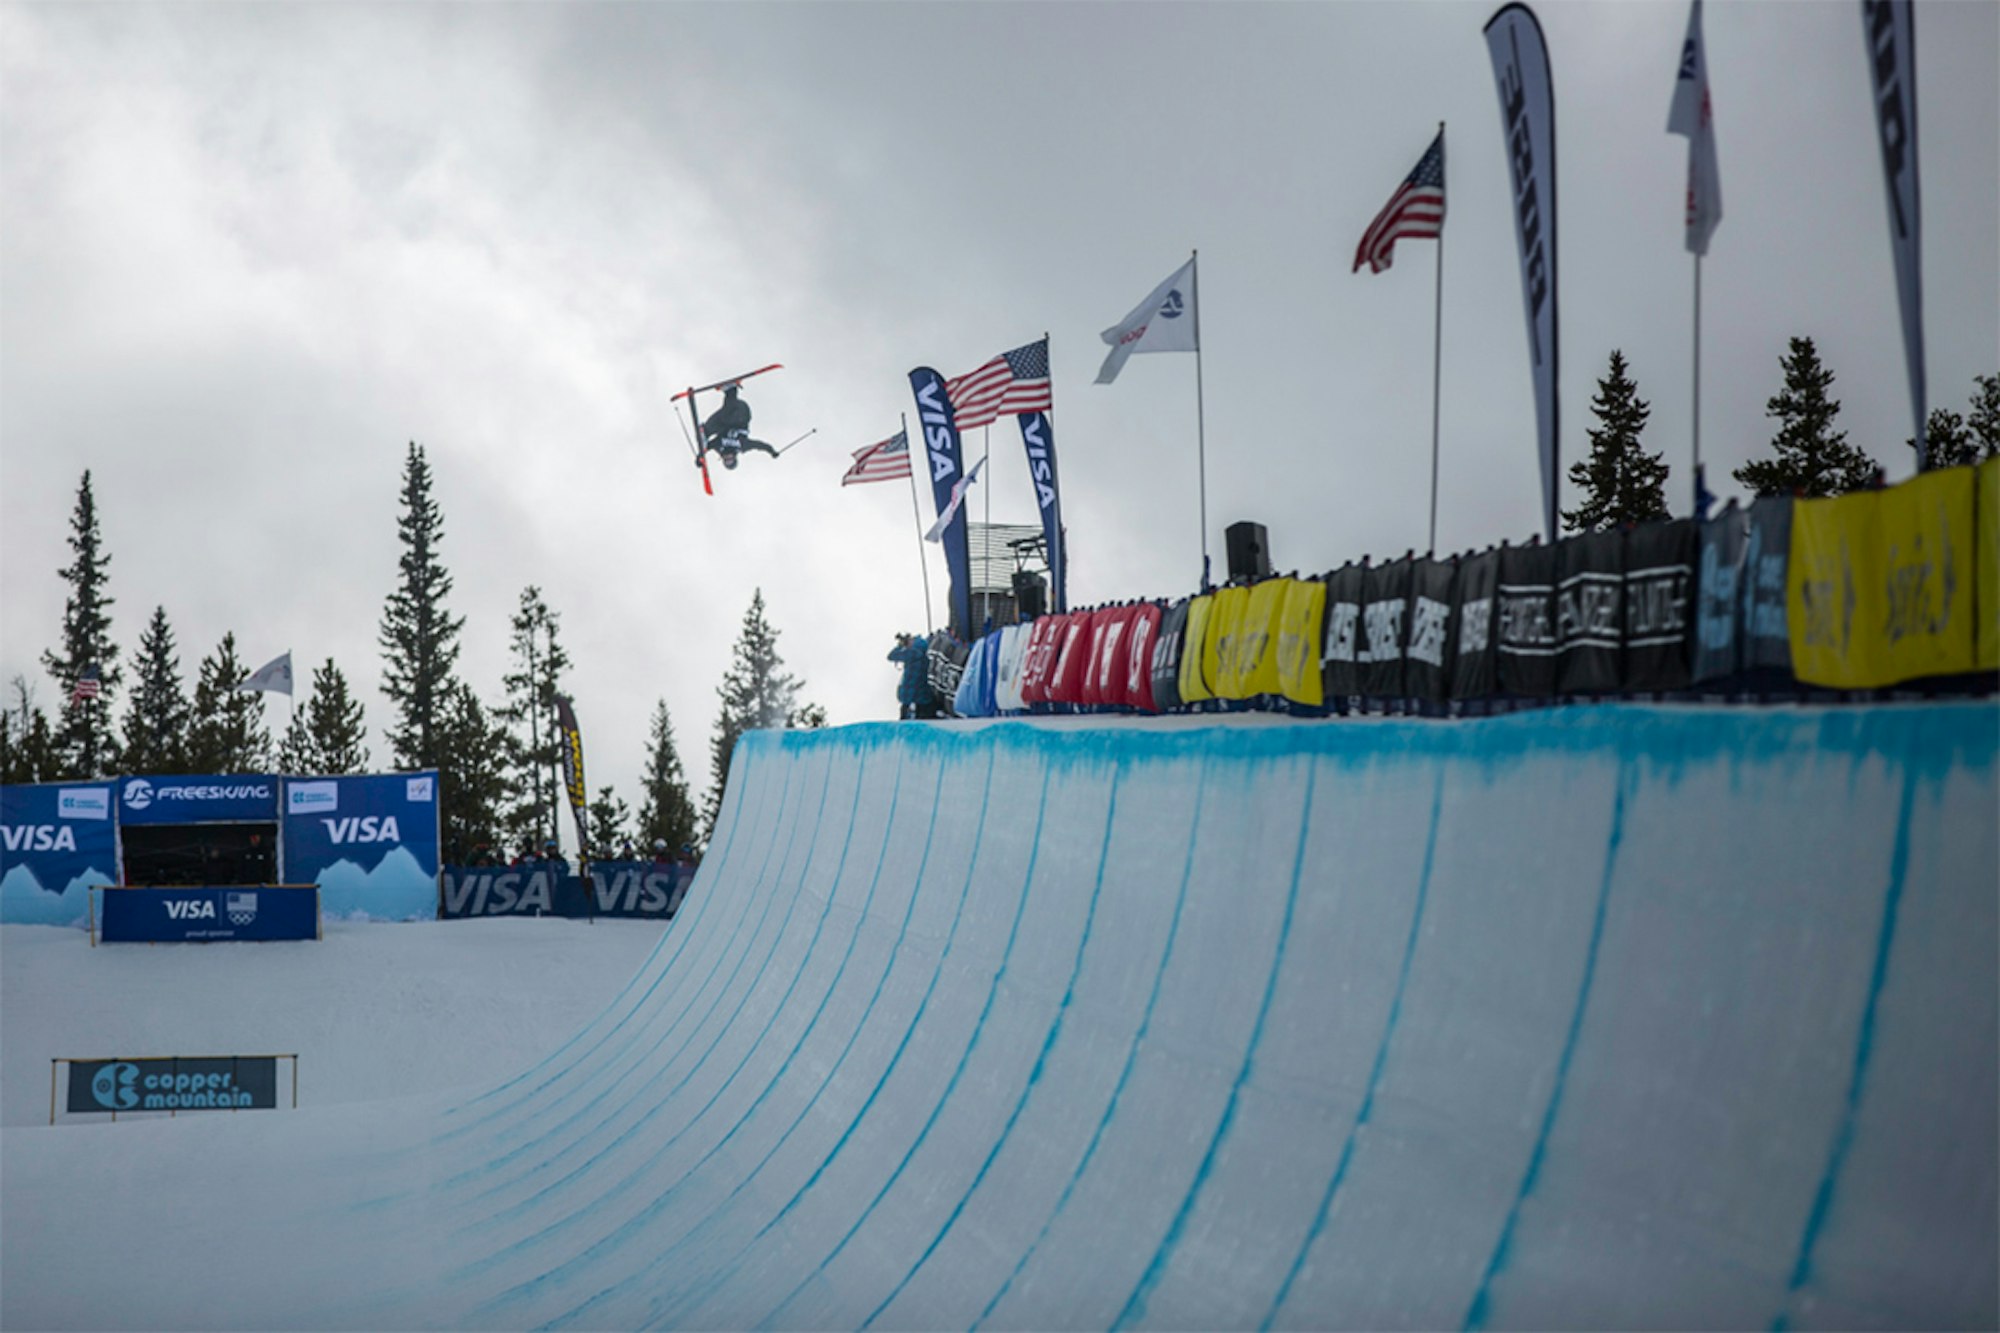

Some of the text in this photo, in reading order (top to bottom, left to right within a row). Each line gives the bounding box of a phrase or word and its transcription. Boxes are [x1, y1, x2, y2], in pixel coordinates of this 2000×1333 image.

[916, 375, 955, 482] VISA
[1024, 413, 1056, 509] VISA
[0, 825, 76, 852] VISA
[321, 816, 400, 844] VISA
[444, 871, 552, 915] VISA
[162, 900, 216, 919] VISA
[144, 1072, 231, 1093] copper
[144, 1087, 253, 1109] mountain
